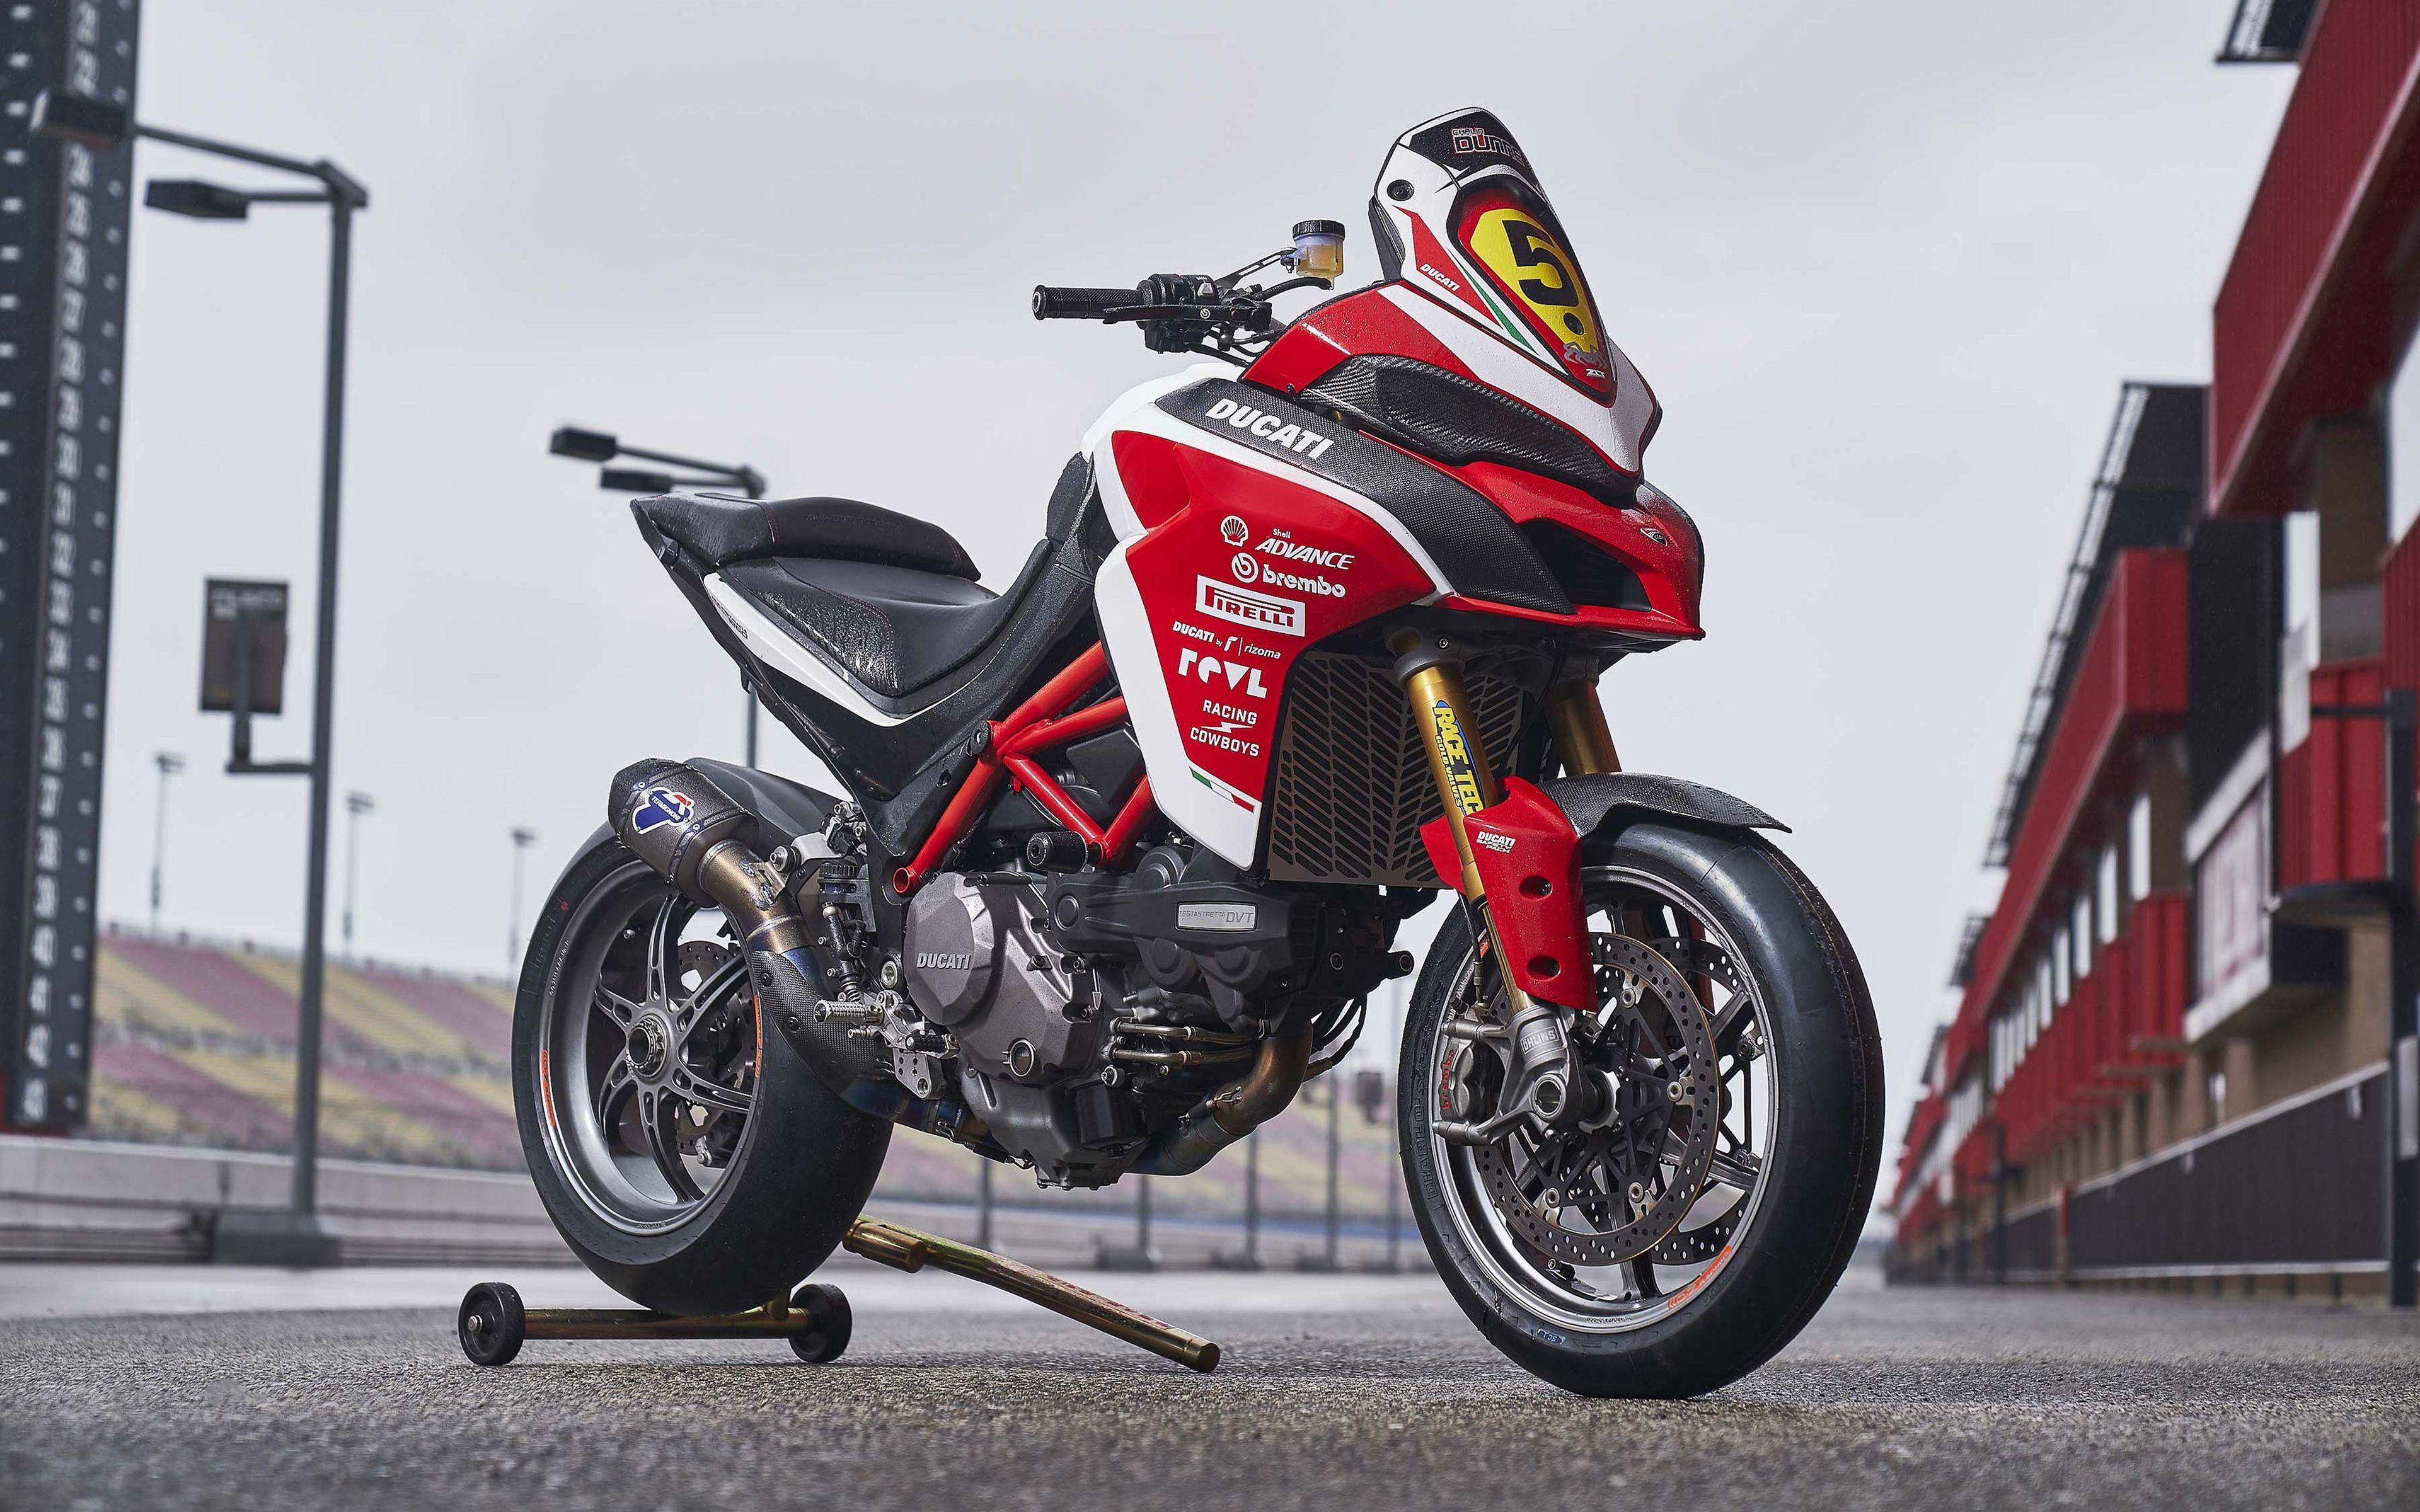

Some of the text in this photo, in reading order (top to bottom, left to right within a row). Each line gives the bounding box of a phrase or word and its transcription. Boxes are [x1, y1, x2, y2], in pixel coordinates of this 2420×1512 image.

[1420, 262, 1461, 292] DUCATI
[1504, 219, 1579, 306] 5
[1206, 398, 1334, 460] DUCATI
[1272, 528, 1291, 539] Shell
[1255, 537, 1355, 570] ADVANCE
[1262, 564, 1347, 598] brembo
[1204, 585, 1295, 627] PIRELLI
[1172, 621, 1215, 643] DUCATI
[1216, 638, 1223, 647] by
[1244, 643, 1281, 660] rizoma
[1202, 699, 1257, 724] RACING
[1190, 726, 1260, 757] COWBOYS
[1432, 707, 1469, 766] RACE
[652, 795, 681, 821] TERMIGNONI
[1477, 831, 1516, 846] DUCATI
[1226, 911, 1254, 924] DVT
[917, 953, 971, 970] DUCATI
[1523, 1029, 1557, 1053] ÖHLINS
[1441, 1050, 1455, 1111] brembo
